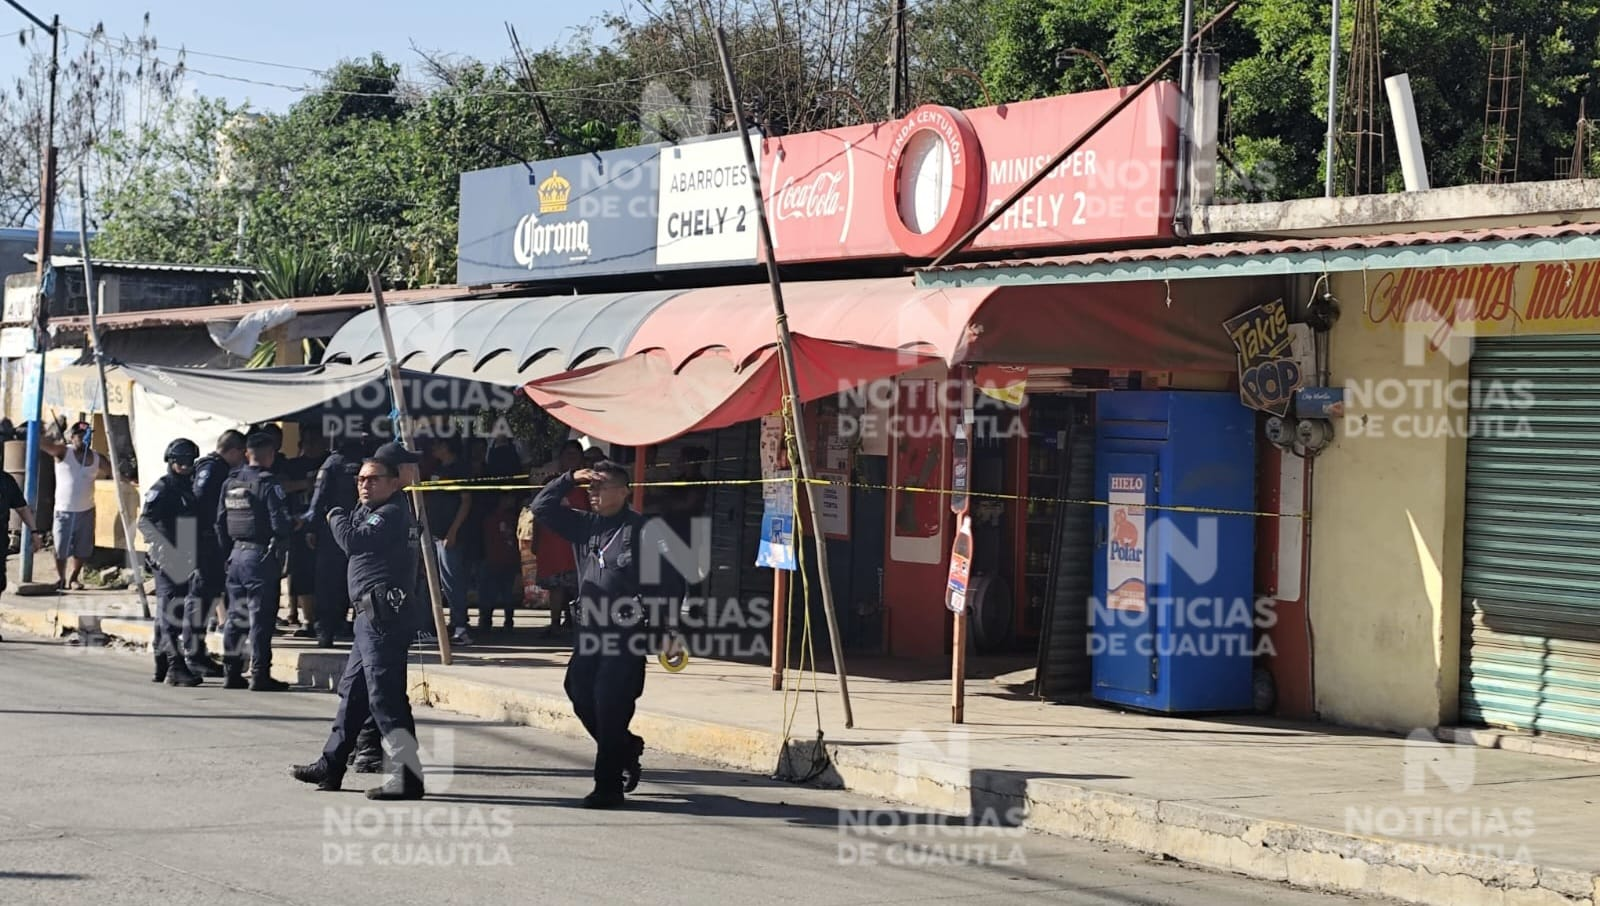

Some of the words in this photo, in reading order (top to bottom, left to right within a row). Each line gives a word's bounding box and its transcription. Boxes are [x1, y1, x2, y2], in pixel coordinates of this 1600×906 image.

[887, 120, 916, 172] TIENDA
[916, 110, 961, 167] CENTURIÓN
[669, 164, 747, 194] ABARROTES
[777, 170, 843, 221] Coca-Cola
[667, 207, 728, 239] CHELY
[735, 205, 747, 233] 2
[988, 192, 1065, 231] CHELY
[1072, 191, 1087, 225] 2
[513, 213, 590, 270] Corona
[1232, 304, 1288, 368] Takis
[1242, 360, 1300, 408] POP
[1111, 477, 1143, 490] HIELO
[1110, 541, 1143, 562] Polar
